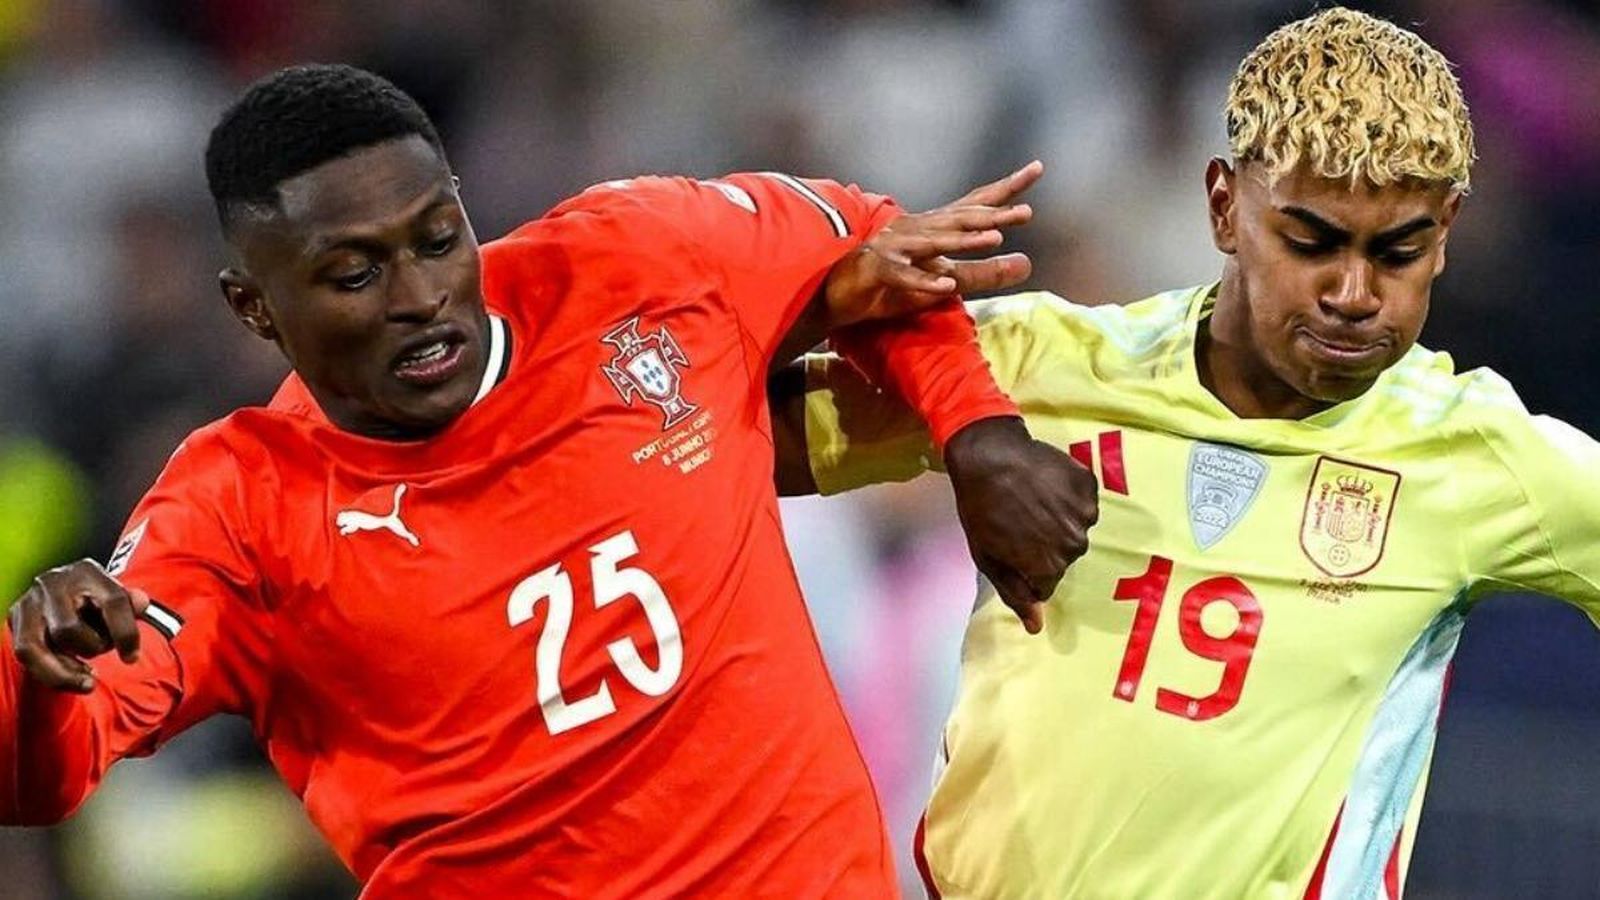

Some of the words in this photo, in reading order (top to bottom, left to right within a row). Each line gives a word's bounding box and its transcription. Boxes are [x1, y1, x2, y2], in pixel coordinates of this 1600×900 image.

[1194, 463, 1256, 489] CHAMPIONS
[1198, 454, 1260, 478] EUROPEAN
[507, 529, 684, 736] 25
[1112, 554, 1264, 721] 19
